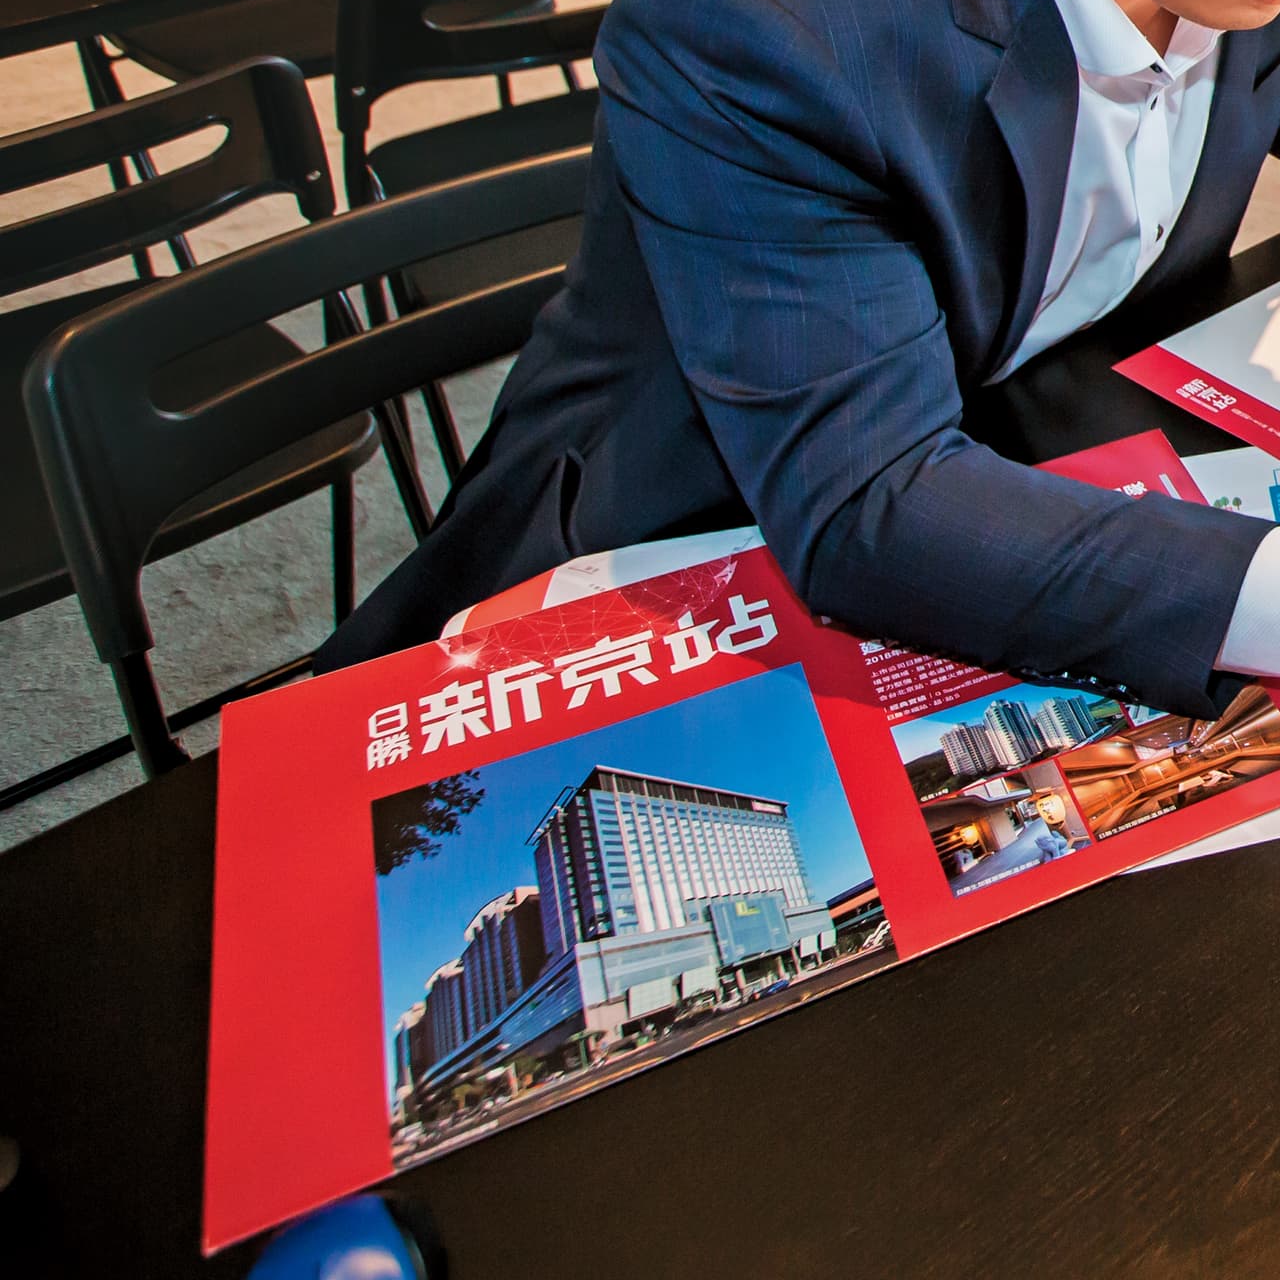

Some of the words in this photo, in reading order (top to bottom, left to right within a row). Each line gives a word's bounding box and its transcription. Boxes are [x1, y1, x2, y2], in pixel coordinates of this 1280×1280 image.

[367, 702, 413, 771] 日勝
[420, 594, 779, 754] 新京站
